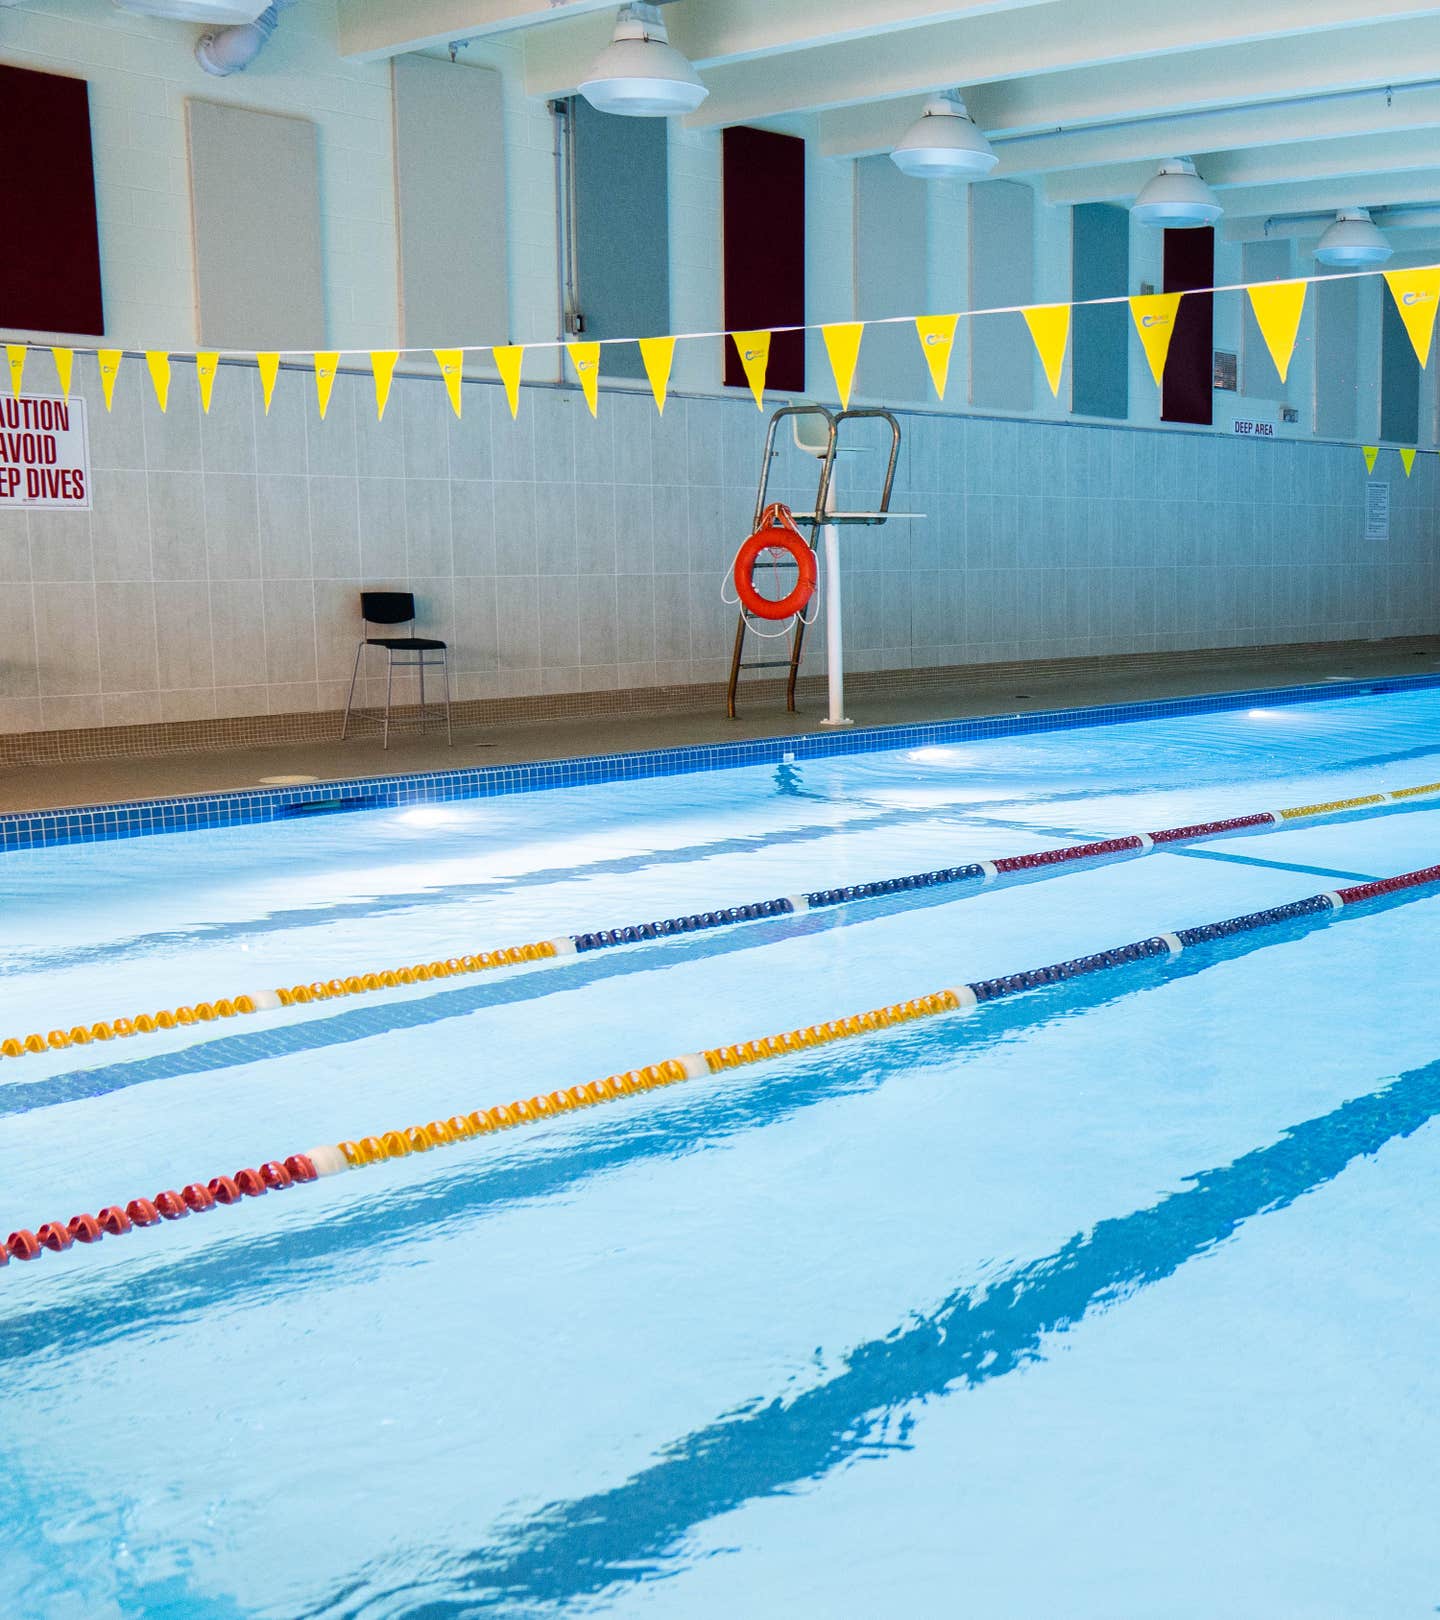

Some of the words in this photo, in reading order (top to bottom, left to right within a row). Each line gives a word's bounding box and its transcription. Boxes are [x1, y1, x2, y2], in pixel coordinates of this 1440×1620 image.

[1235, 421, 1252, 433] DEEP
[1255, 423, 1273, 436] AREA
[26, 468, 85, 500] DIVES
